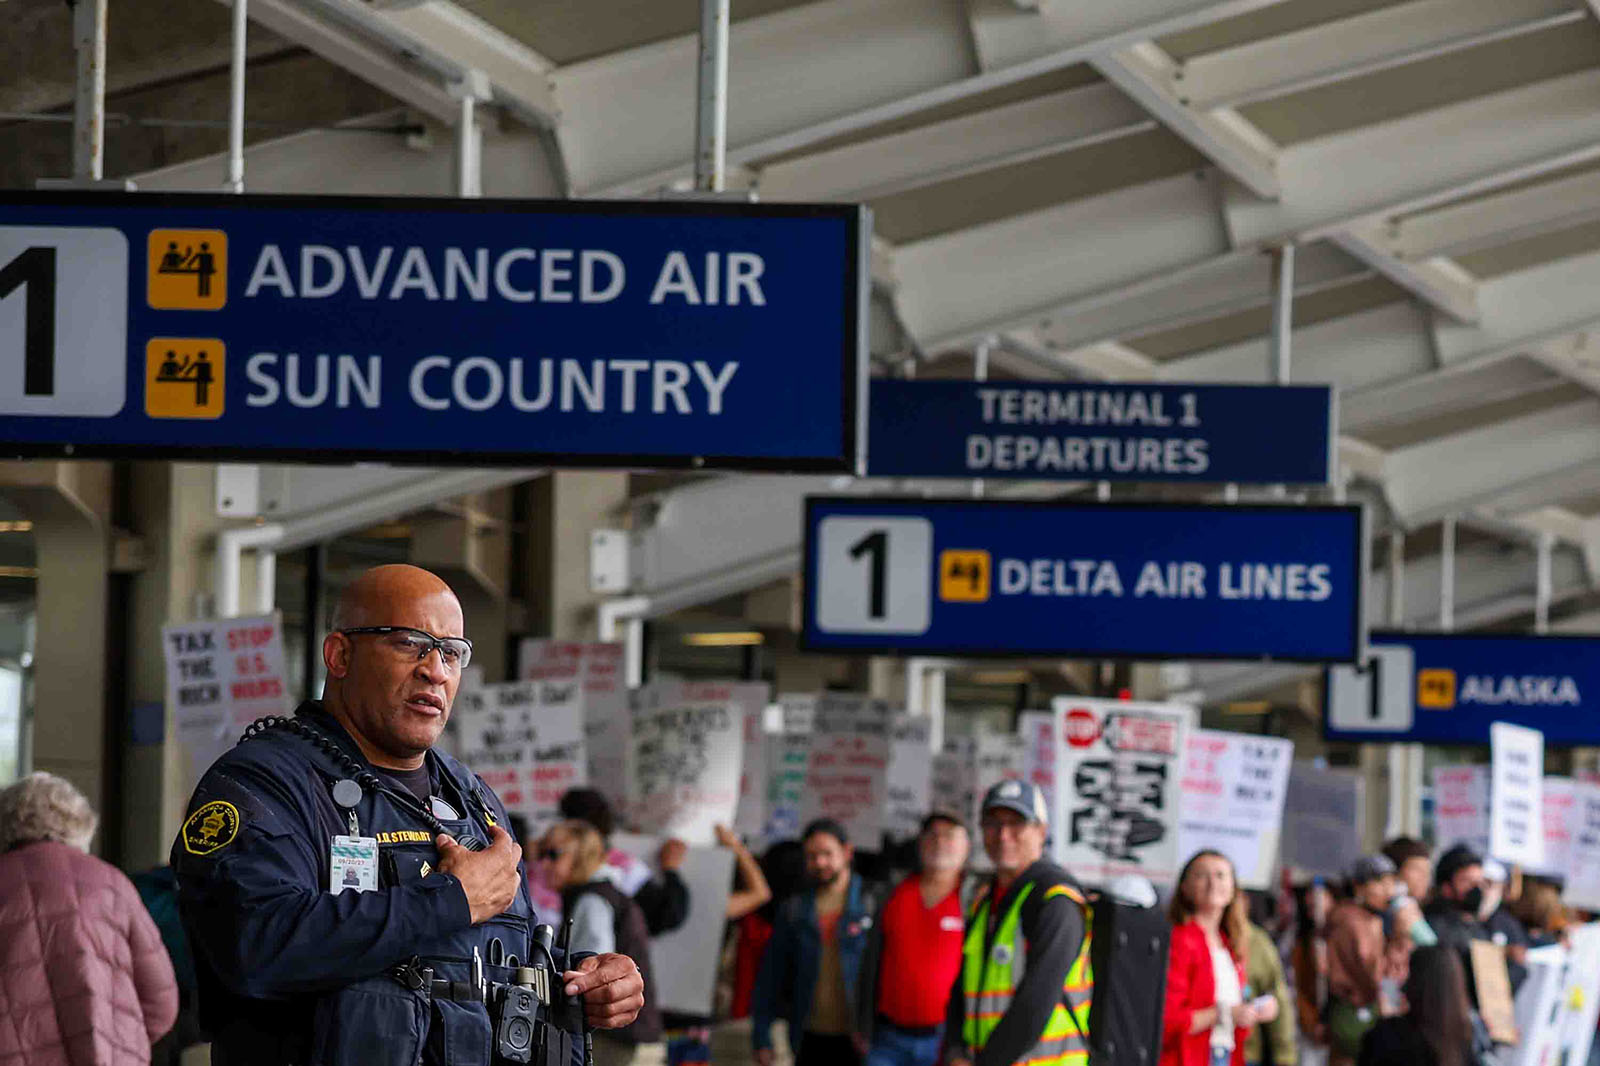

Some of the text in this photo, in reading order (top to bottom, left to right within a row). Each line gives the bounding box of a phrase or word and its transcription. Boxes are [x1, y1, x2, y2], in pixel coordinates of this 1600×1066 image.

[245, 245, 767, 306] ADVANCED AIR
[0, 247, 57, 396] 1
[246, 353, 740, 415] SUN COUNTRY
[977, 390, 1201, 426] TERMINAL 1
[966, 434, 1210, 474] DEPARTURES
[847, 529, 1332, 620] 1 DELTA AIR LINES
[170, 630, 215, 653] TAX
[1360, 656, 1580, 719] 1 ALASKA
[392, 830, 431, 843] STEWART
